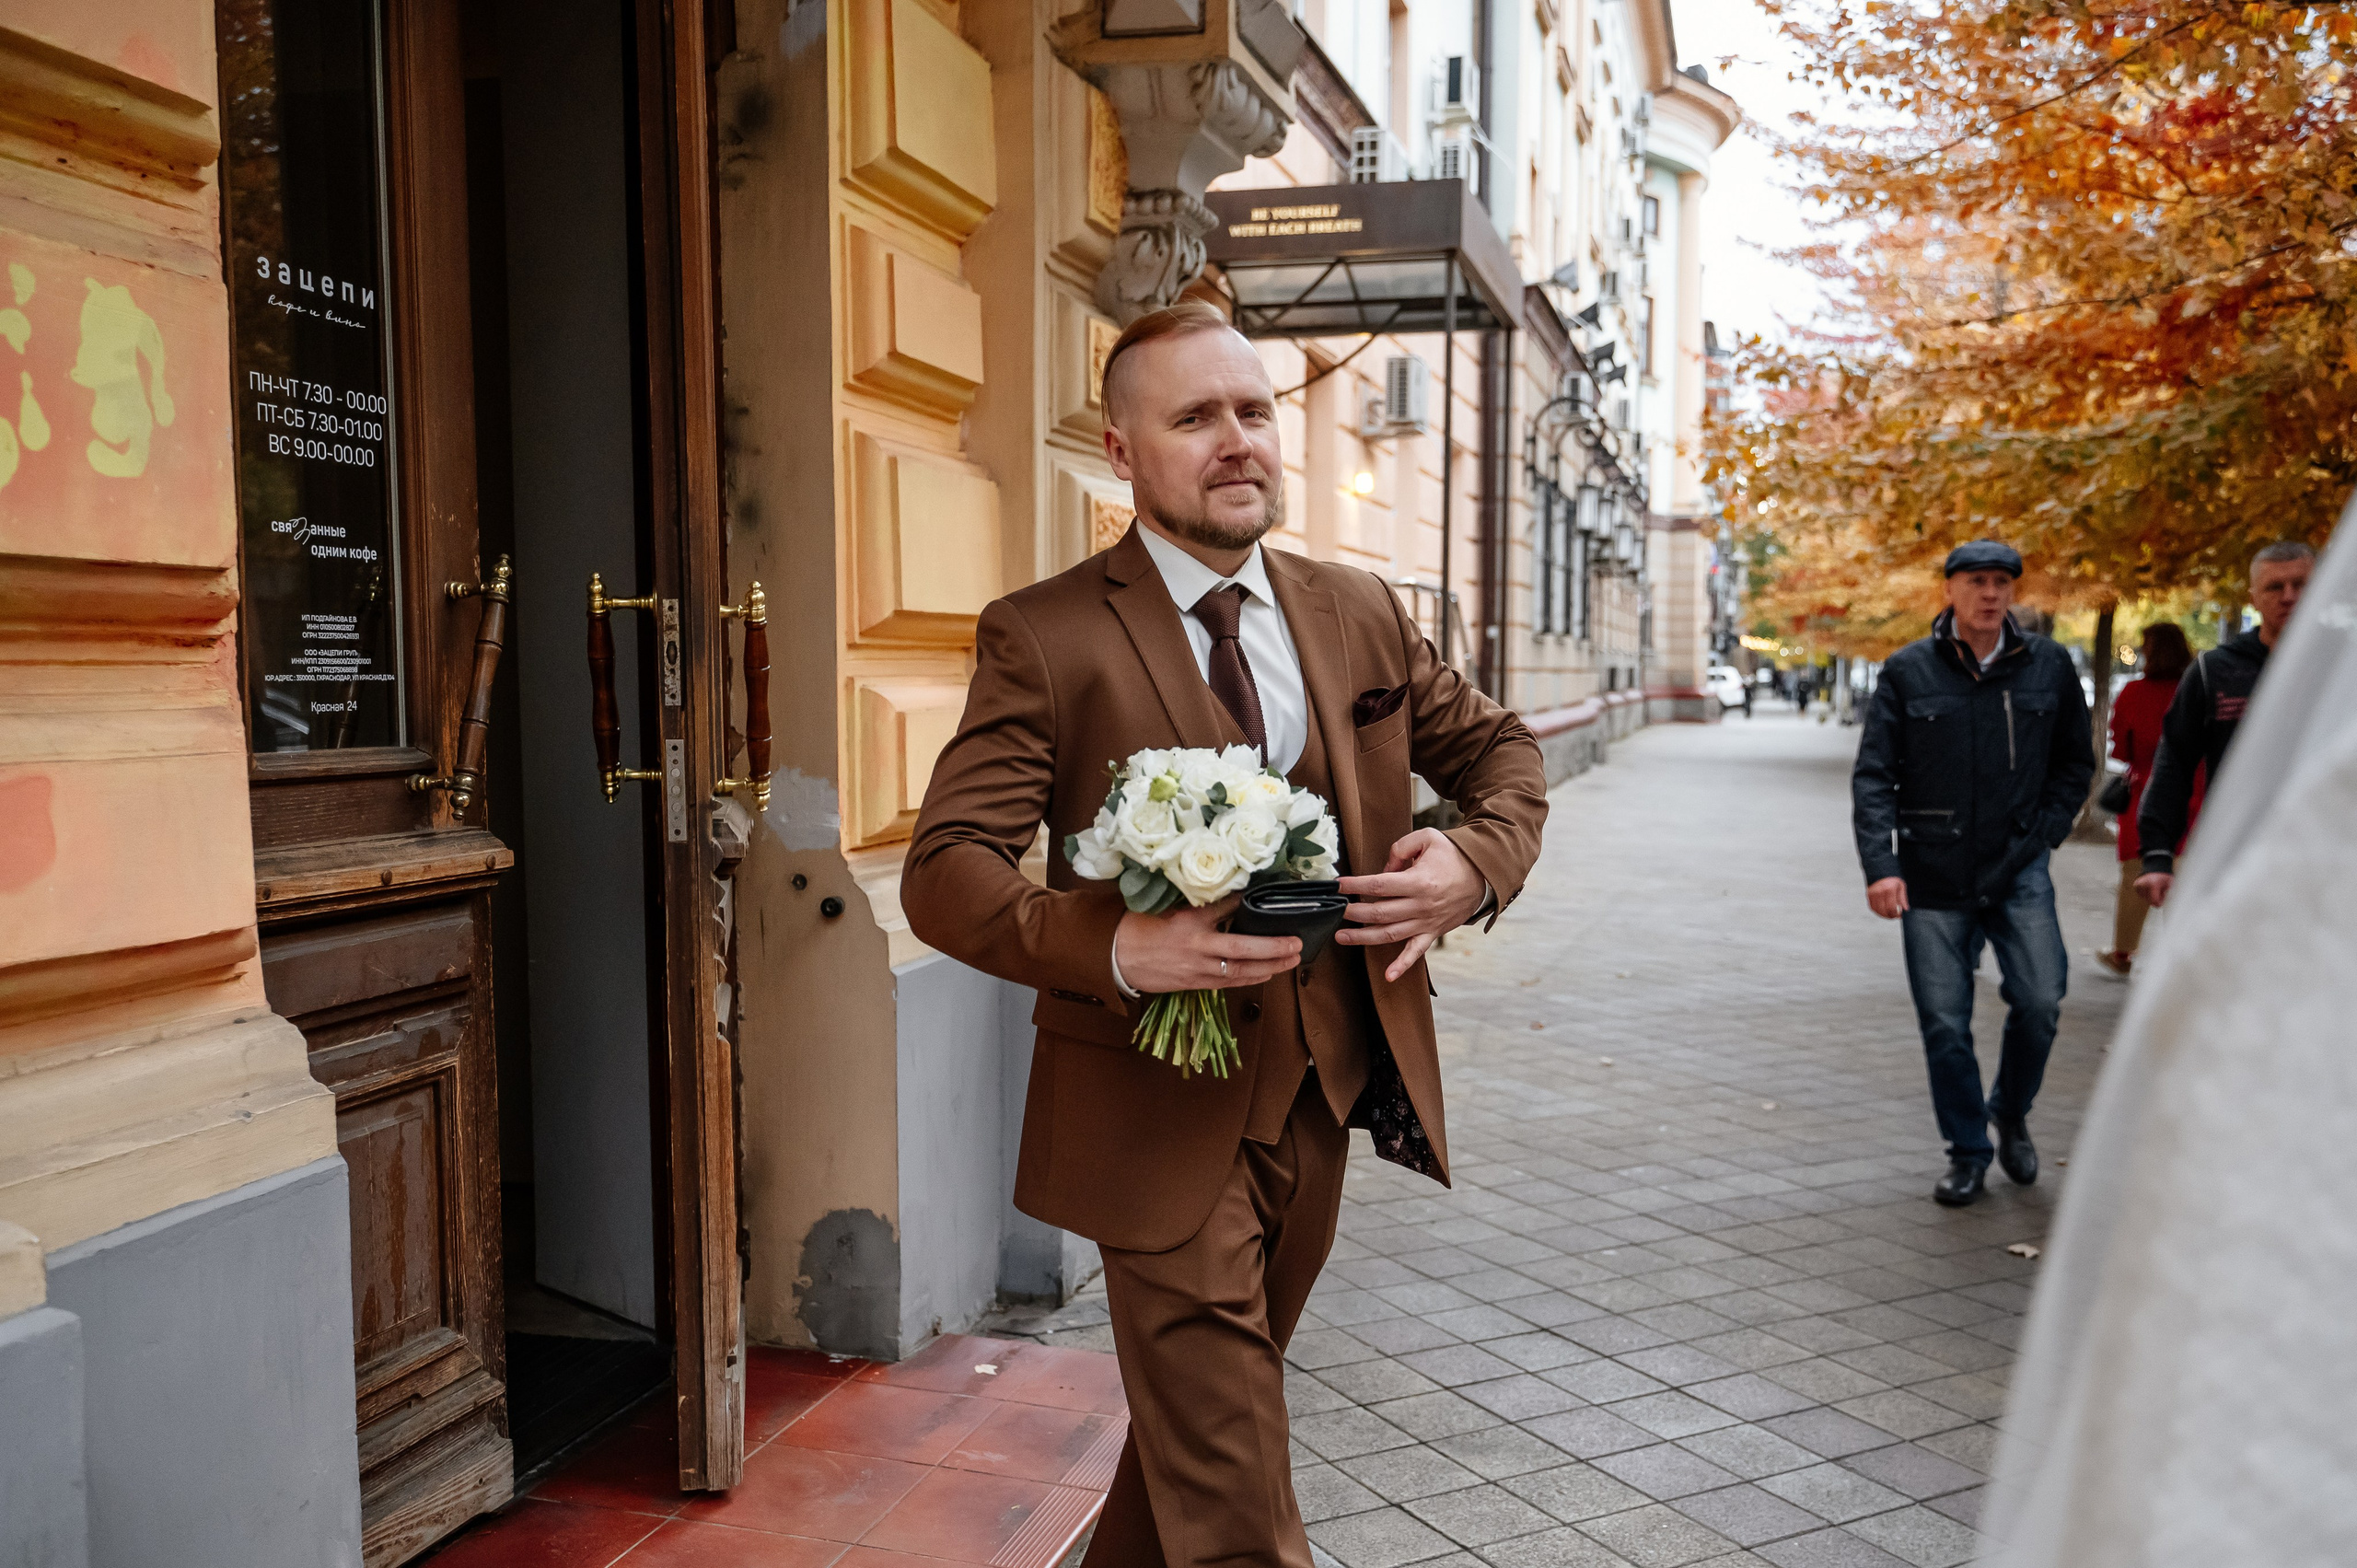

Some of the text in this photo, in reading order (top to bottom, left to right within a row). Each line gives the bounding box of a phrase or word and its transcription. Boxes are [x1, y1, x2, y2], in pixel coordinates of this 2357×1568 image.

[1271, 203, 1341, 220] YOURSELF
[1228, 223, 1267, 238] WITH
[1268, 221, 1306, 237] EACH
[257, 256, 375, 310] зацепи
[309, 308, 320, 317] и
[250, 371, 299, 398] ПН-ЧТ
[302, 381, 332, 404] 7.30
[346, 390, 387, 414] 00.00
[257, 402, 382, 441] ПТ-СБ 7.30-01.00
[269, 434, 375, 467] ВС 9.00-00.00
[311, 544, 377, 563] одним кофе
[310, 700, 358, 714] Красная 24
